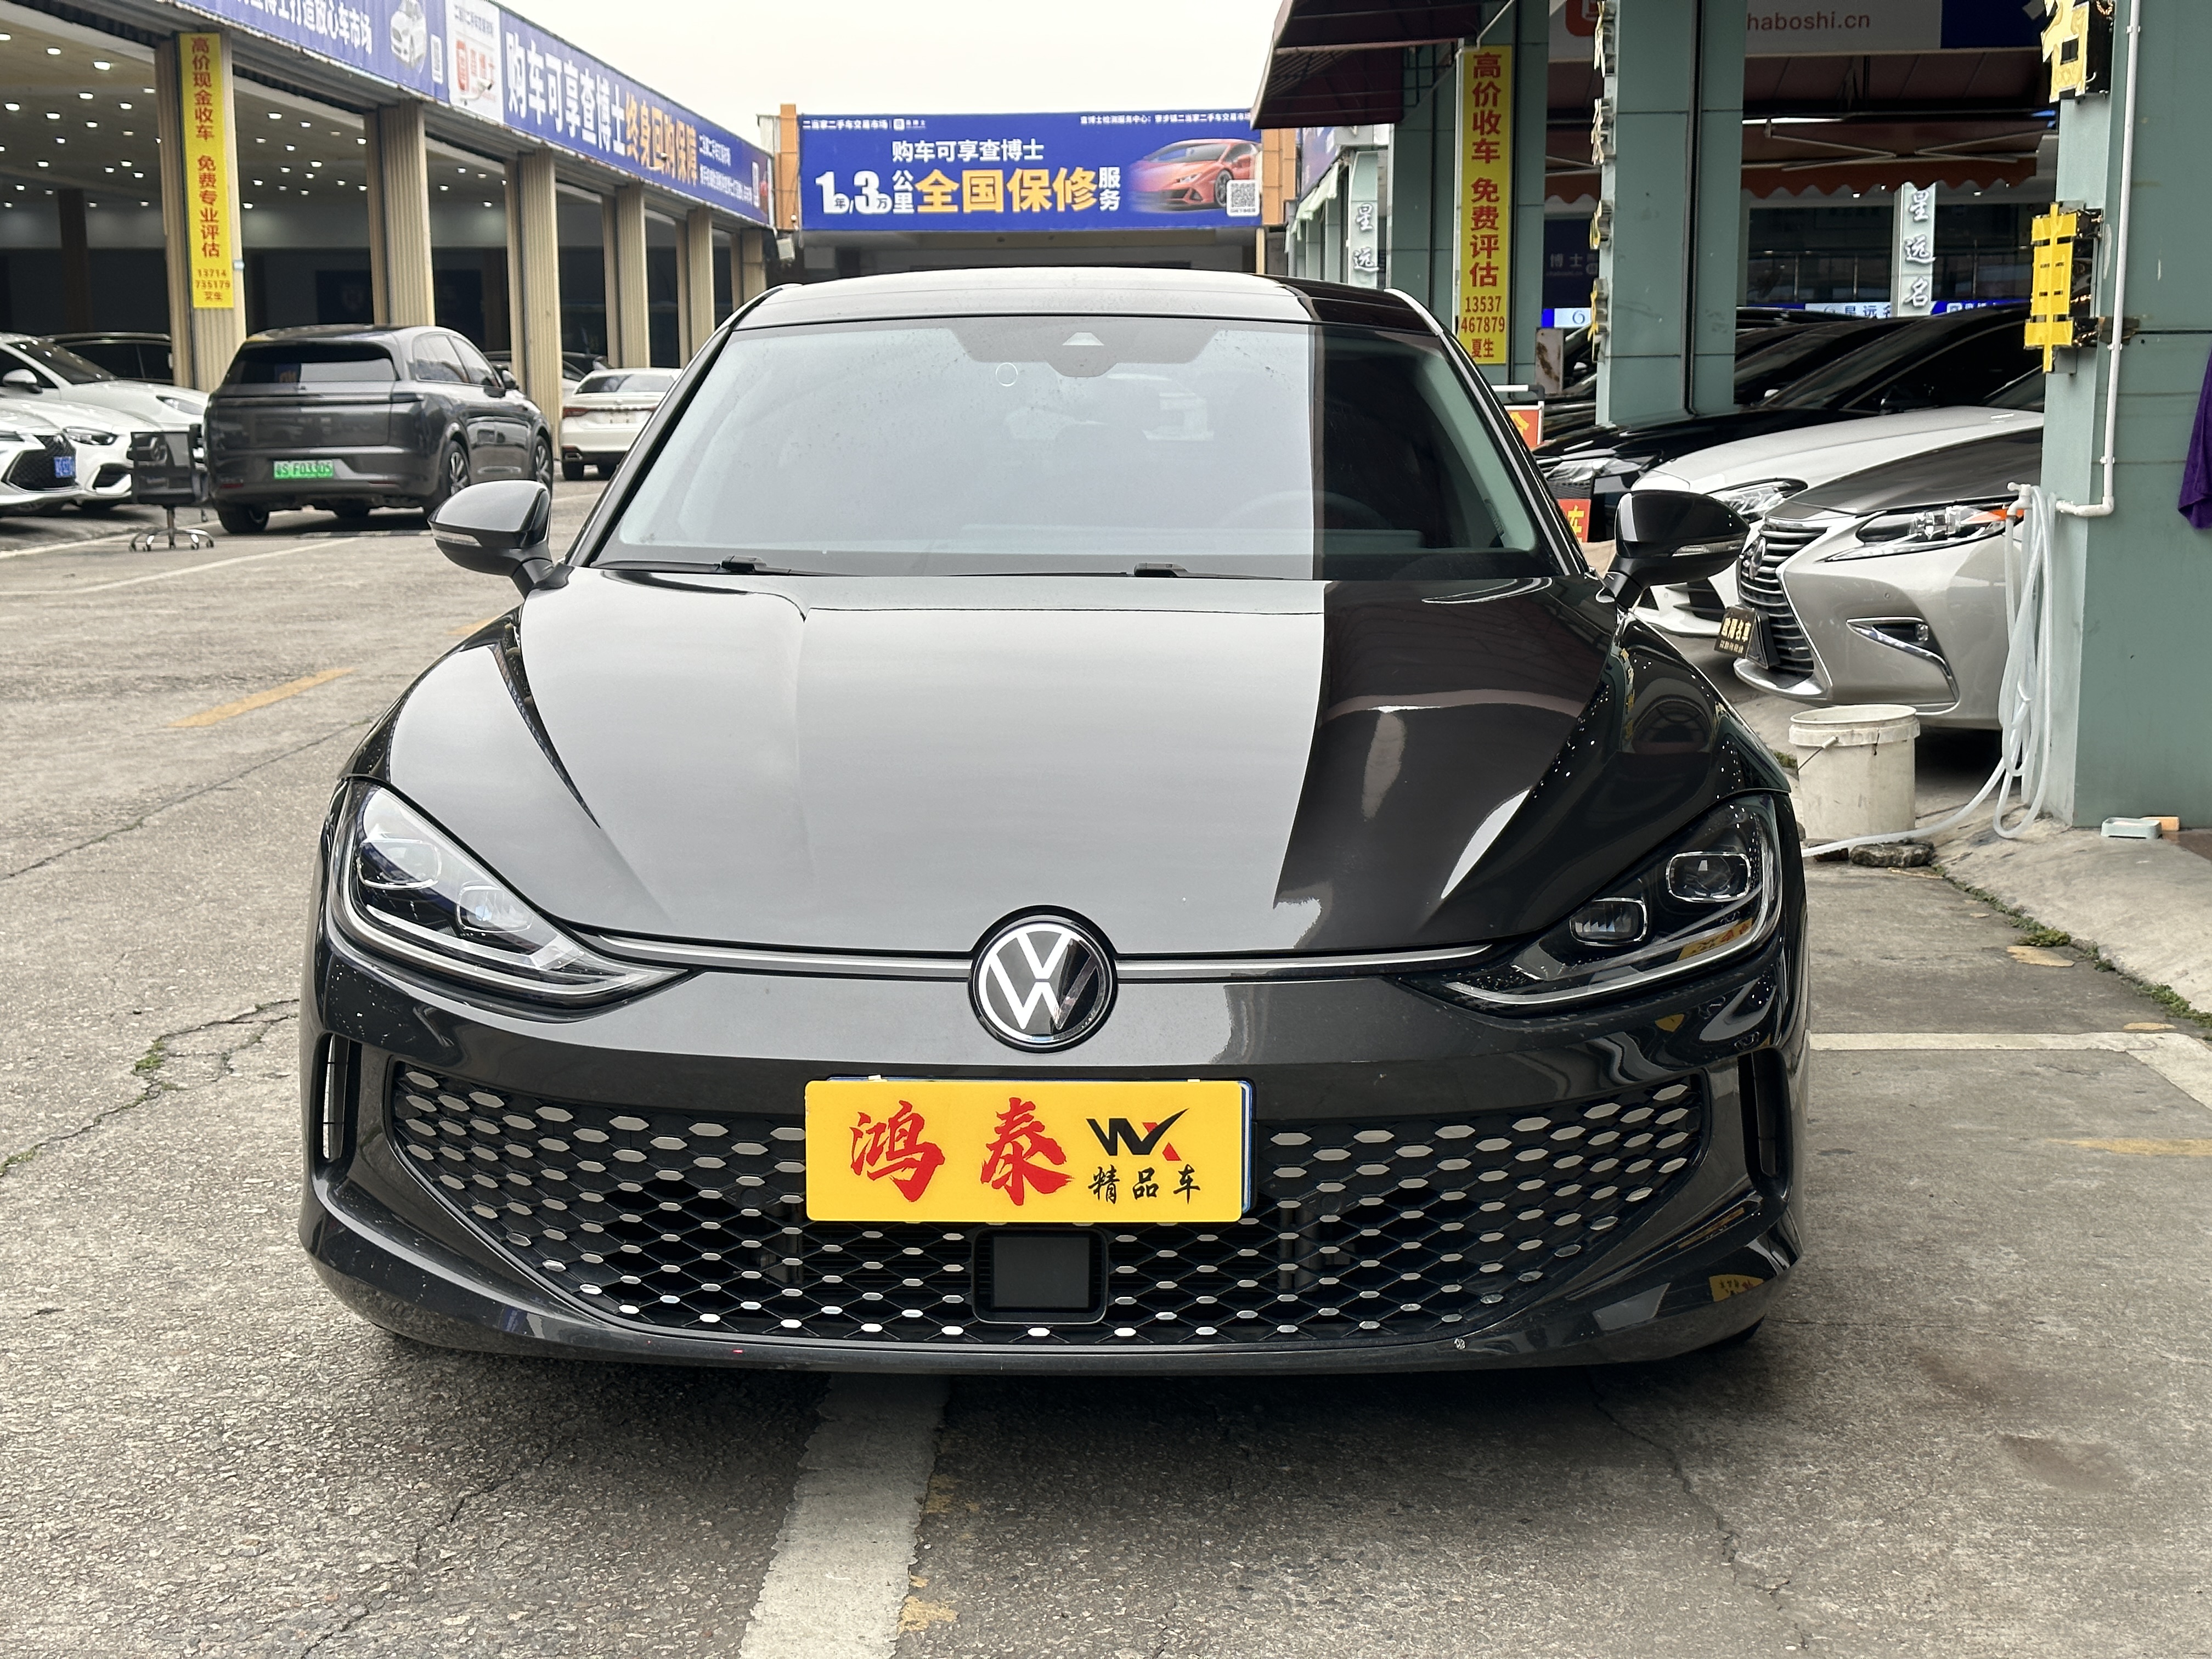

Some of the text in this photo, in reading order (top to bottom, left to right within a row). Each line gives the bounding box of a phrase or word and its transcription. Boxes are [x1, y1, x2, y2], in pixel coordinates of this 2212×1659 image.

[191, 37, 220, 258] 高价现金收车 免费专业评估
[892, 138, 1045, 162] 购车可享查博士
[1469, 52, 1502, 287] 高价收车 免费评估
[1465, 296, 1502, 313] 13537
[1460, 315, 1505, 333] 467879
[1471, 338, 1494, 358] 夏生
[849, 1097, 1075, 1206] 鸿泰
[1087, 1164, 1201, 1205] 精品车
